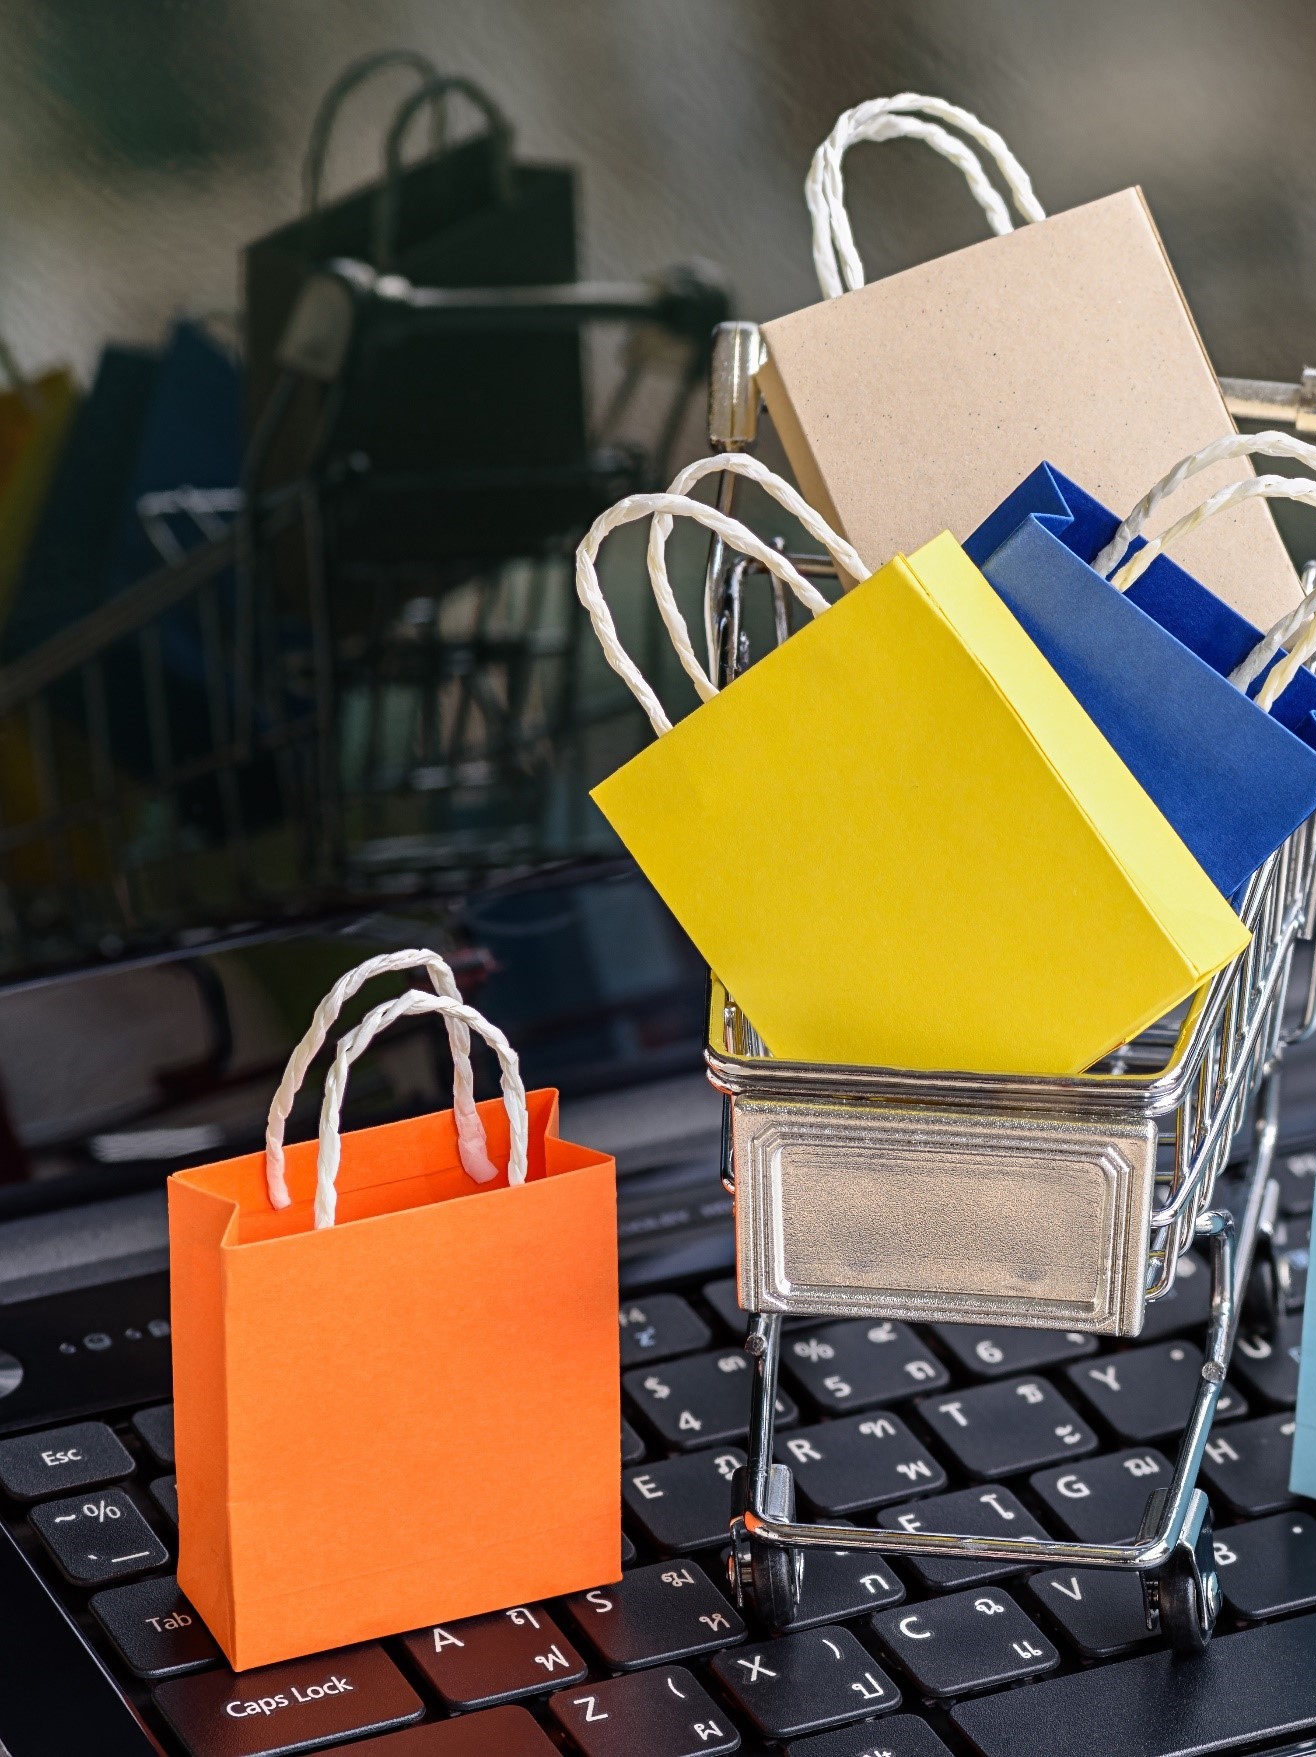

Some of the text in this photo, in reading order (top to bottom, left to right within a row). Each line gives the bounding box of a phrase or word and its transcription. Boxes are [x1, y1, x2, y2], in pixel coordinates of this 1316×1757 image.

[793, 1338, 835, 1362] %
[976, 1340, 1003, 1364] 6
[644, 1377, 671, 1399] $
[824, 1375, 852, 1398] 5
[1090, 1366, 1121, 1391] Y
[678, 1411, 702, 1431] 4
[939, 1401, 968, 1427] T
[41, 1448, 82, 1467] Esc
[787, 1438, 822, 1463] R
[1204, 1438, 1240, 1465] H
[632, 1474, 664, 1499] E
[1056, 1474, 1091, 1499] G
[82, 1499, 121, 1523] %
[897, 1513, 922, 1532] F
[1212, 1542, 1238, 1567] B
[1050, 1576, 1082, 1601] V
[586, 1590, 613, 1613] S
[144, 1612, 192, 1633] Tab
[899, 1615, 931, 1639] C
[433, 1627, 465, 1653] A
[736, 1655, 777, 1682] X
[224, 1675, 354, 1718] Caps Lock
[851, 1672, 885, 1700] ป
[573, 1696, 609, 1722] Z
